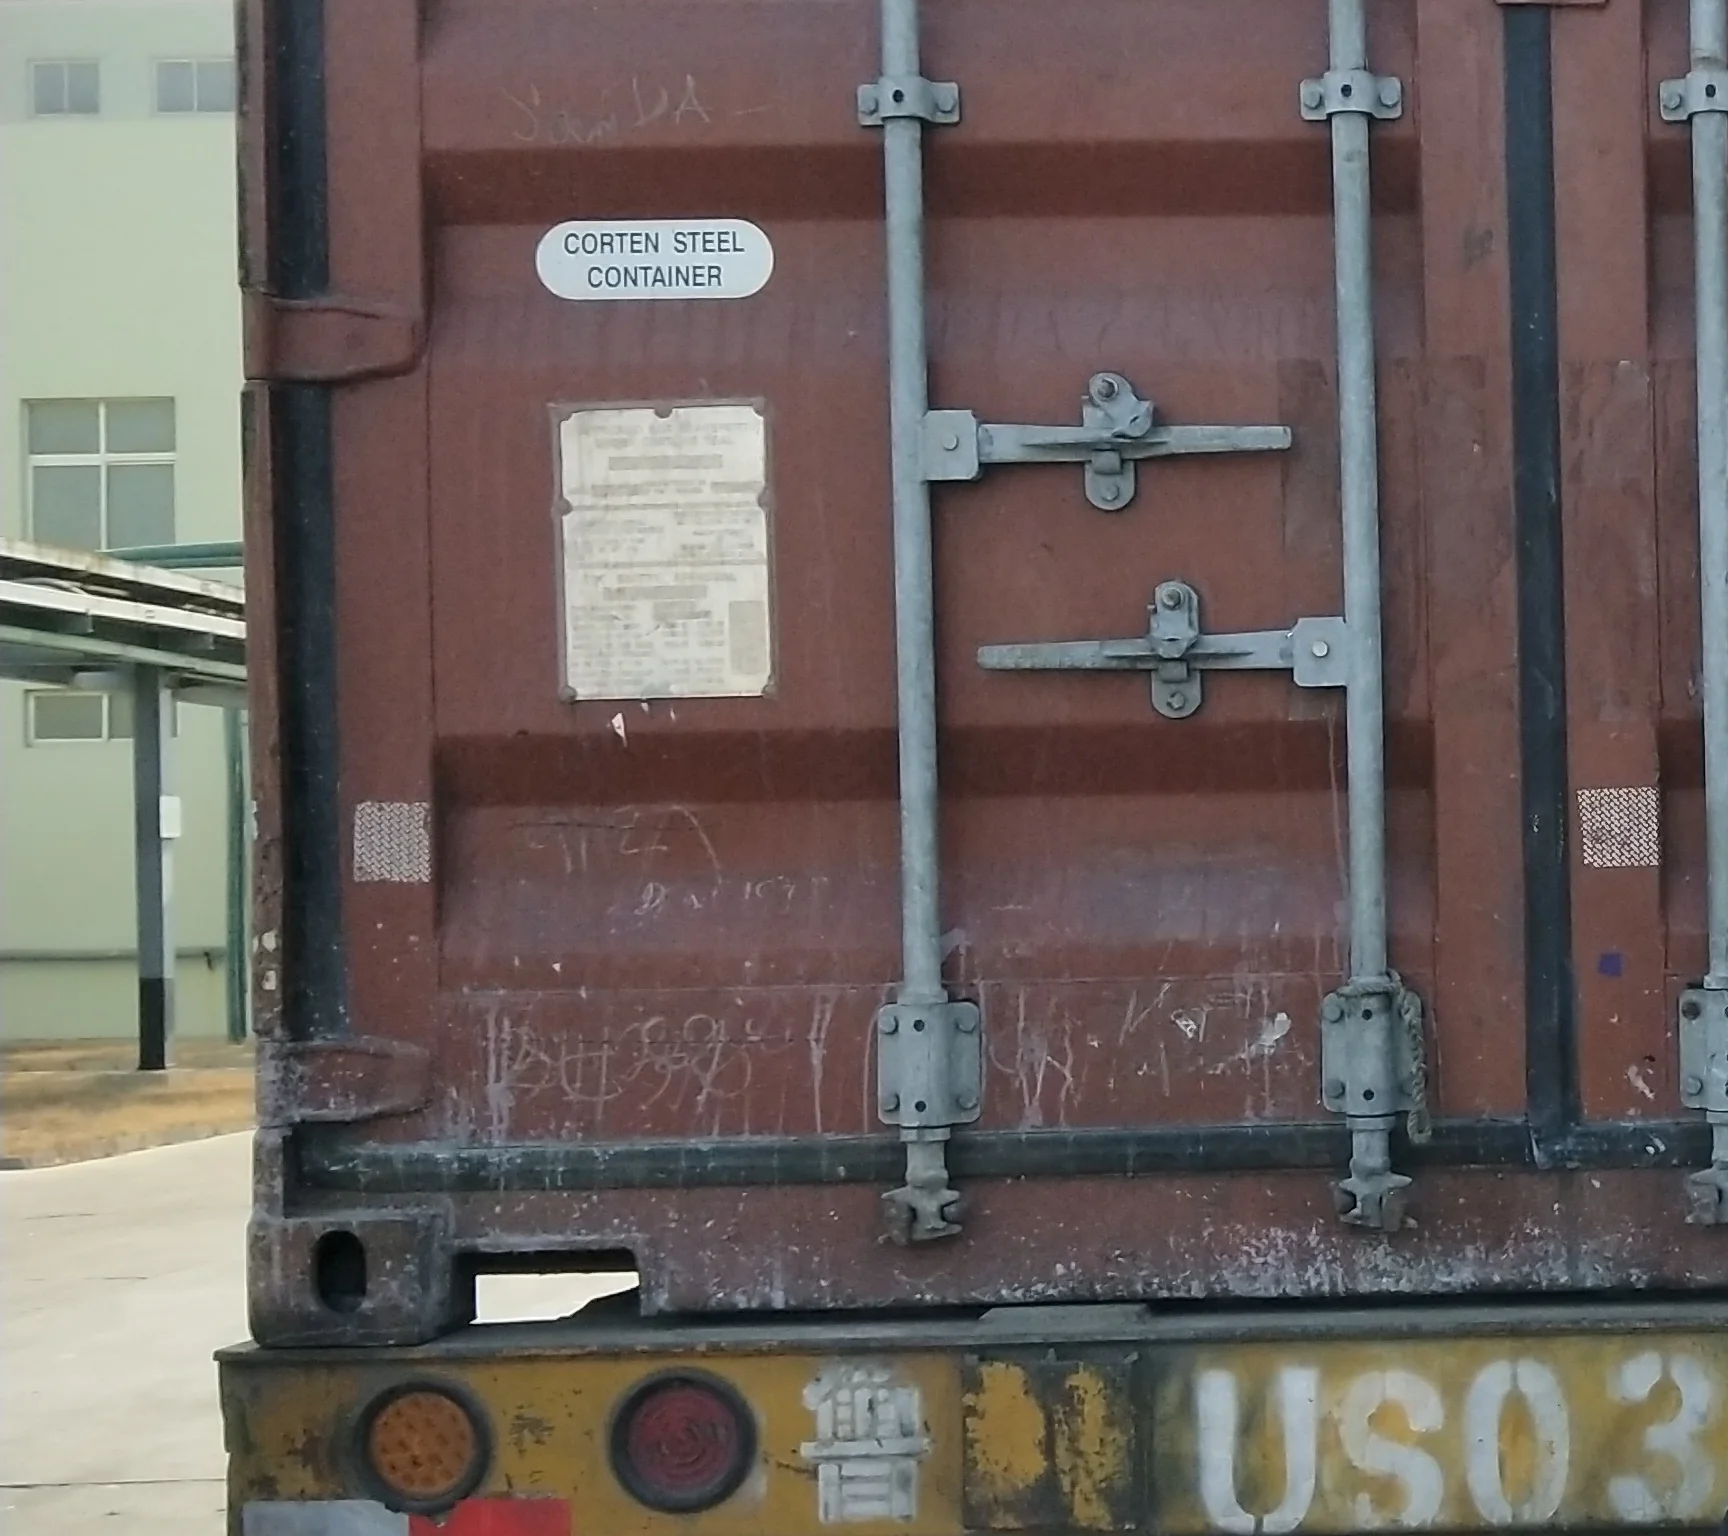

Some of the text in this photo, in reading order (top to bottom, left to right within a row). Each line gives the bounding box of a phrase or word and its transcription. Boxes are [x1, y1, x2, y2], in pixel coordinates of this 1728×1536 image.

[563, 231, 745, 254] CORTEN STEEL
[587, 265, 723, 288] CONTAINER
